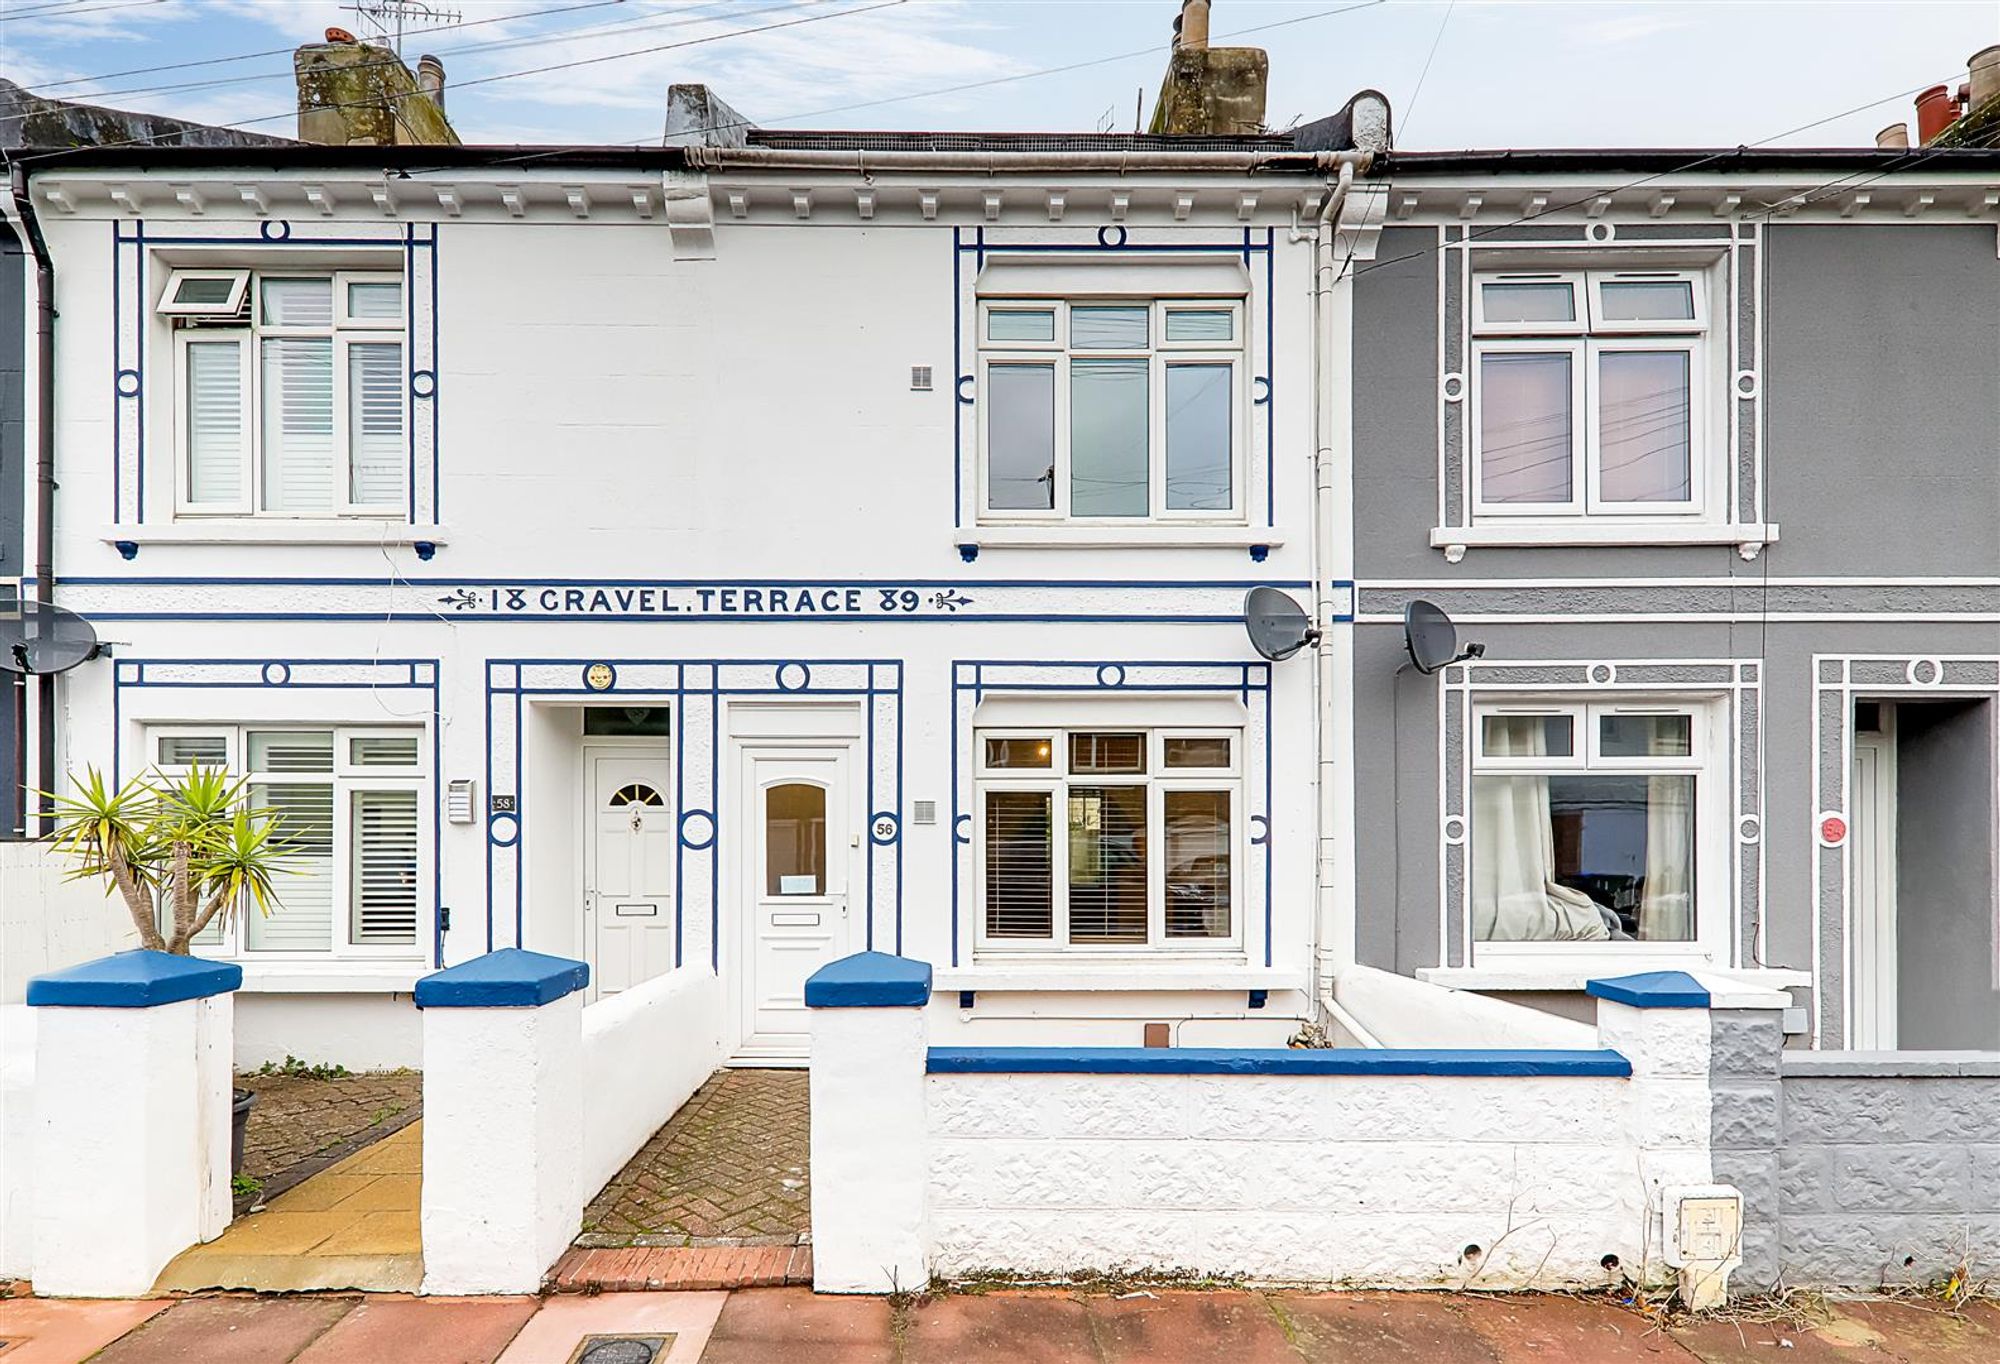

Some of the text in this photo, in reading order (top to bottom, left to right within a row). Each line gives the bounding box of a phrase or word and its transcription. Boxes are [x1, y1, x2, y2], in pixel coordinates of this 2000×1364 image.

[492, 589, 527, 612] 18
[878, 589, 920, 612] 89
[496, 798, 511, 809] 58
[876, 823, 893, 835] 56
